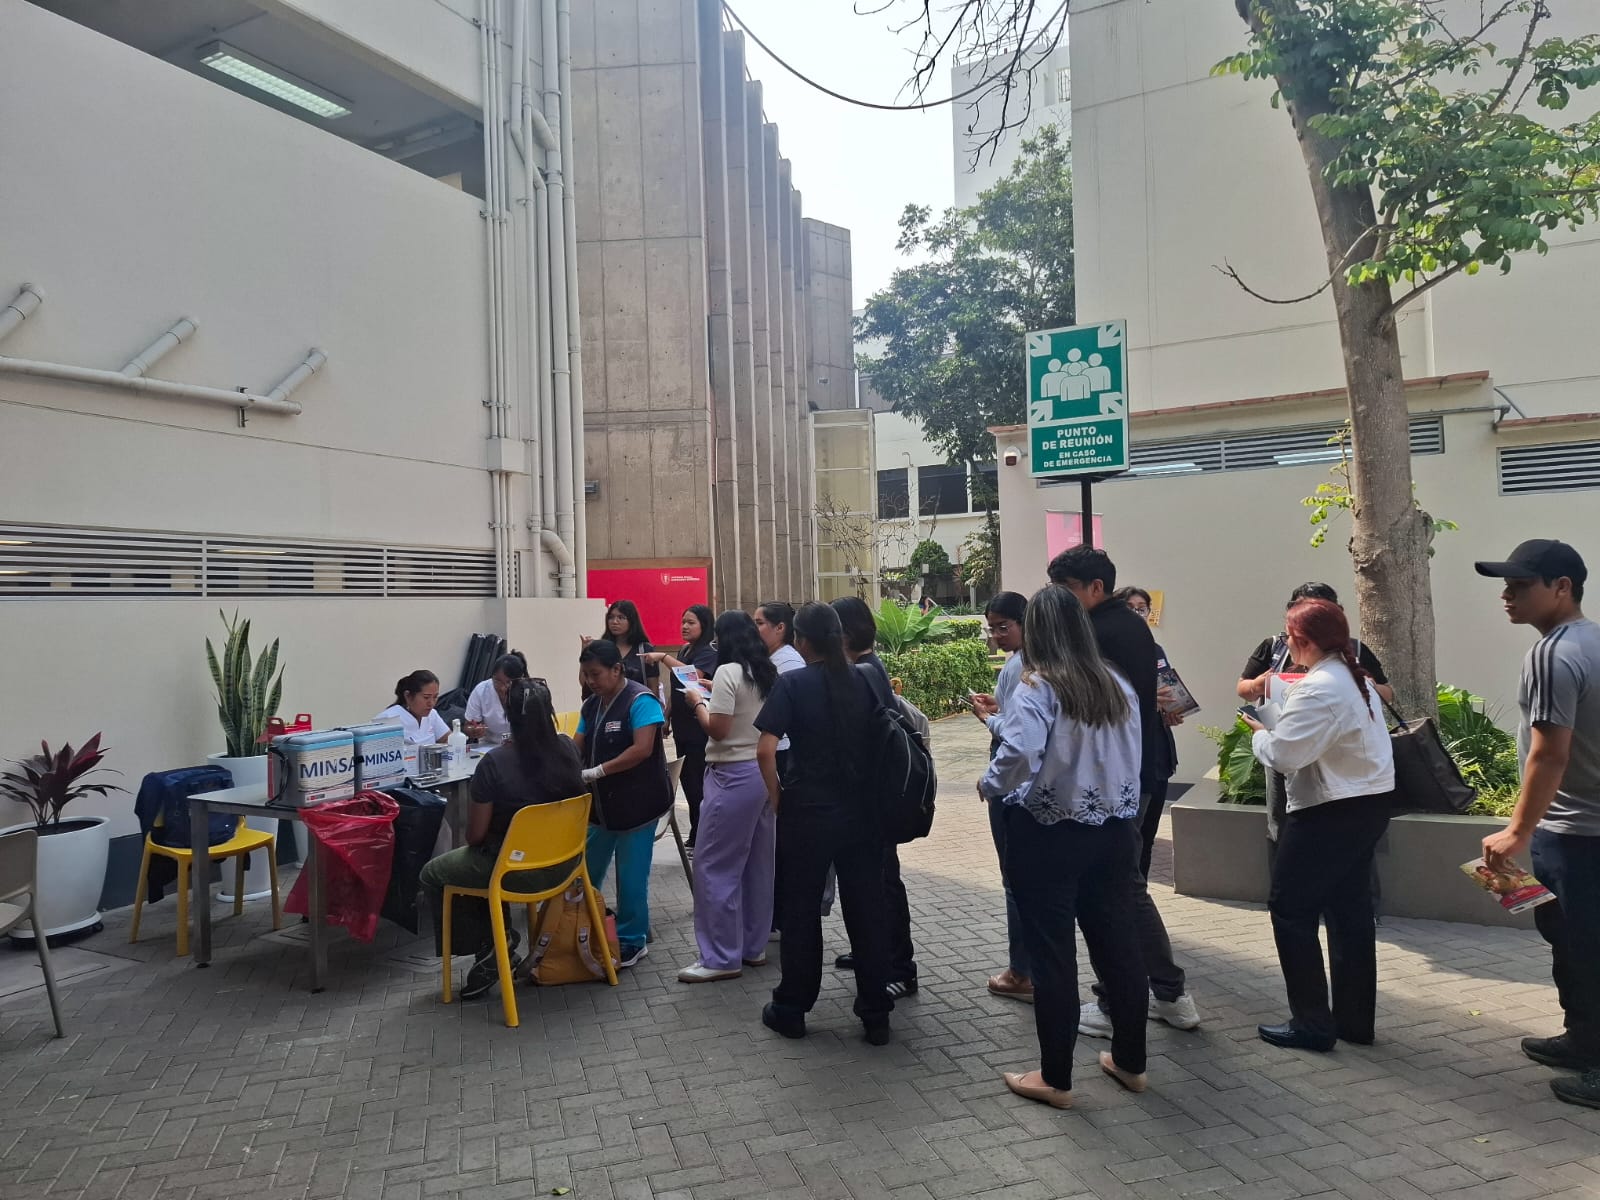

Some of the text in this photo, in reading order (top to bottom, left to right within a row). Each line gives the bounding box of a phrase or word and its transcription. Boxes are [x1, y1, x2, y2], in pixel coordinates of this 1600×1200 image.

[1057, 426, 1096, 438] PUNTO
[1042, 434, 1113, 450] DE REUNIÓN
[1072, 449, 1096, 457] CASO
[1056, 455, 1112, 467] EMERGENCIA
[365, 749, 402, 766] MINSA
